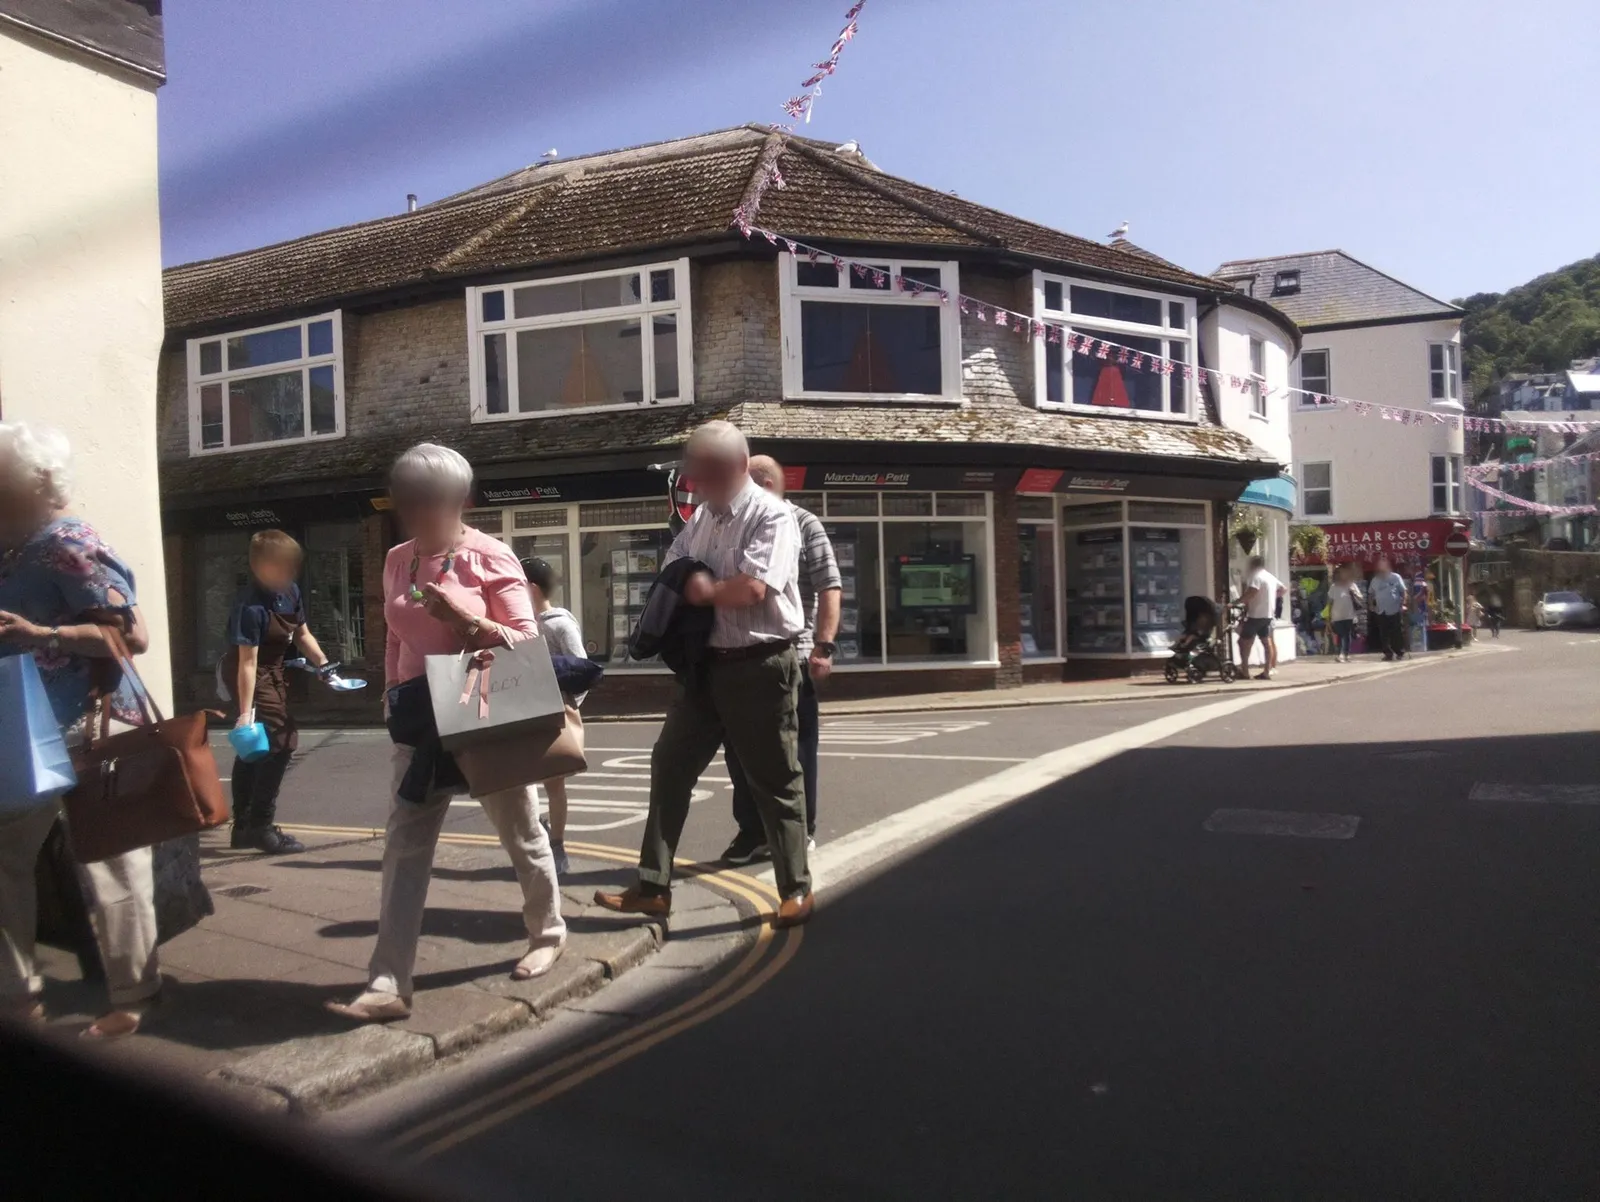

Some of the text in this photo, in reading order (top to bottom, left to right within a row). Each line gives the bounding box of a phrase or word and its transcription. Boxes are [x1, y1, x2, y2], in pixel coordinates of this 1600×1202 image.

[824, 472, 910, 482] Marchand Petit
[483, 485, 559, 498] Marchand Petit
[1391, 541, 1415, 550] TOYS
